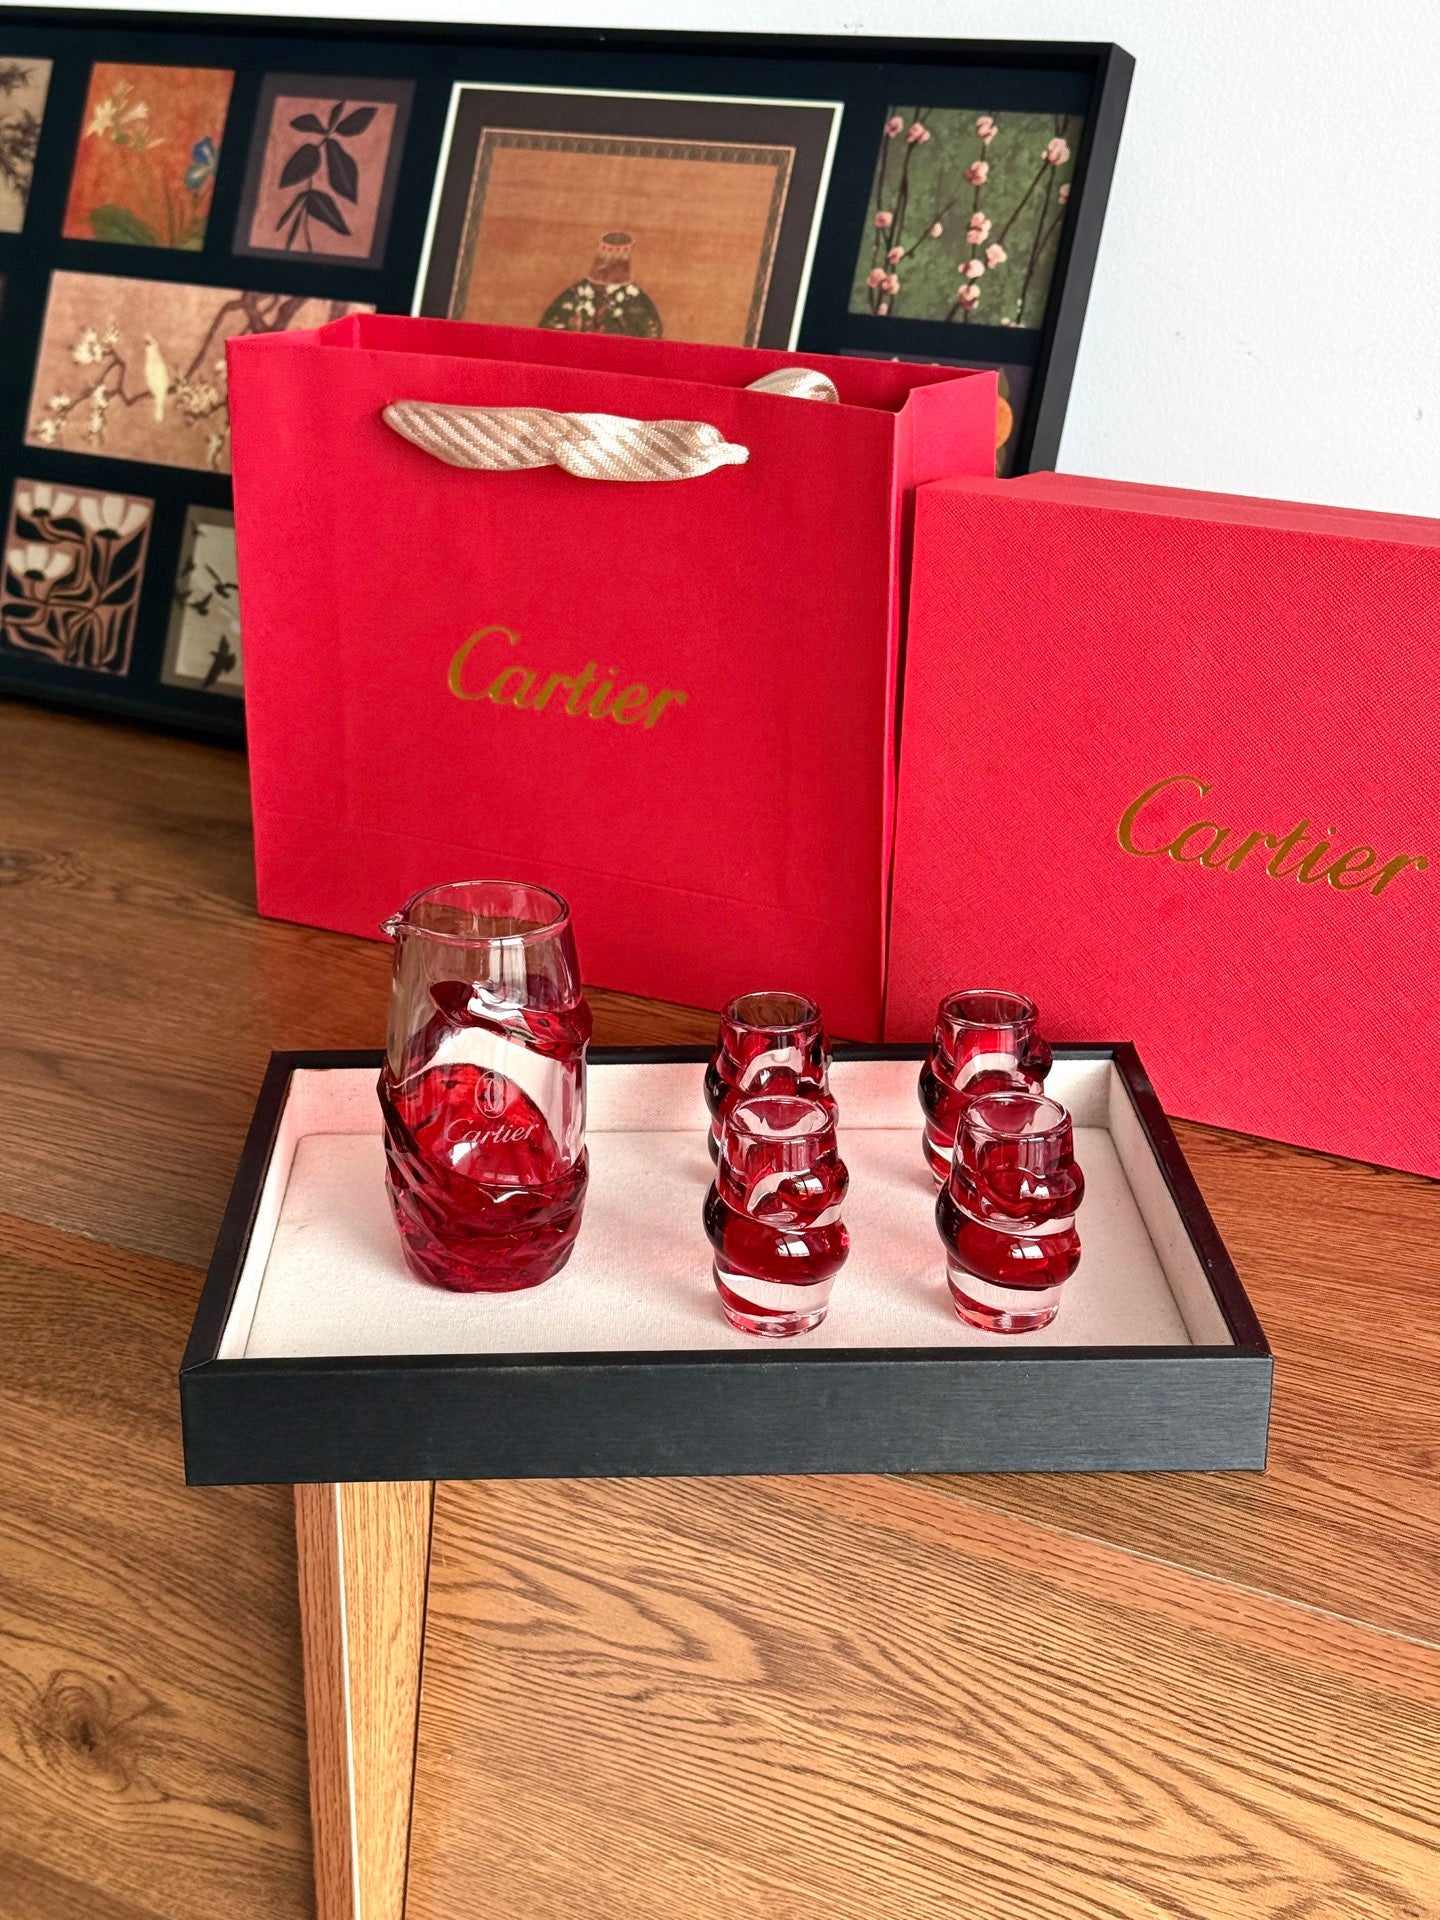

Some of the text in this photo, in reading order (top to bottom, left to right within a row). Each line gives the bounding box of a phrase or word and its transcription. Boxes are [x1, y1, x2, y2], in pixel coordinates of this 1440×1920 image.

[448, 624, 688, 728] Cartier
[1117, 774, 1429, 896] Cartier
[444, 1118, 540, 1145] Cartier
